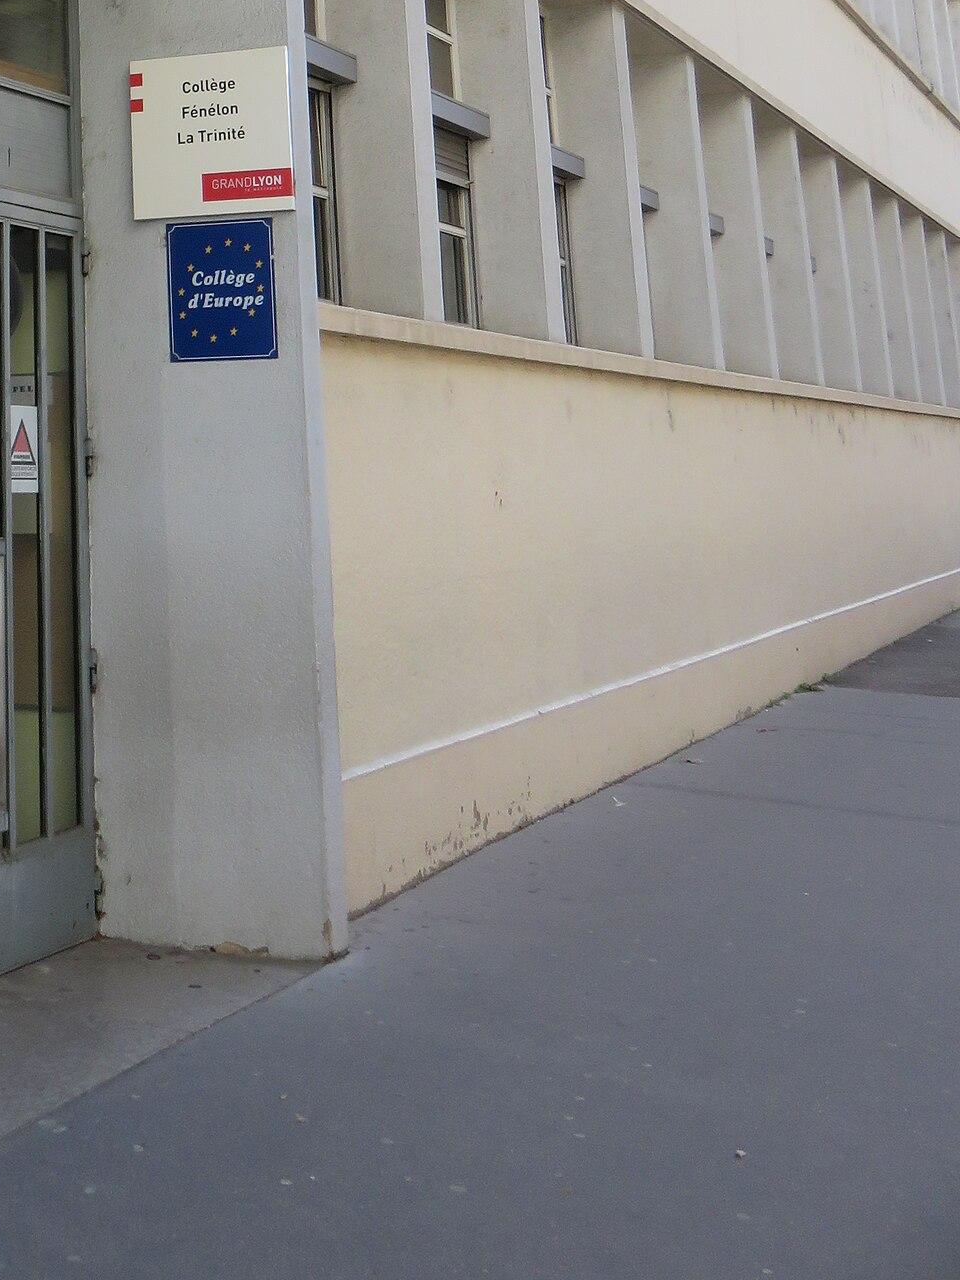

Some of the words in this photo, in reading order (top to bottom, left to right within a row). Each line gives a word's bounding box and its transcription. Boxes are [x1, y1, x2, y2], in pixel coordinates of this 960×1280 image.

[182, 78, 236, 94] Collège
[182, 103, 239, 119] Fénélon
[177, 131, 195, 145] La
[198, 125, 246, 142] Trinité
[191, 270, 256, 287] Collège
[187, 292, 265, 310] d'Europe
